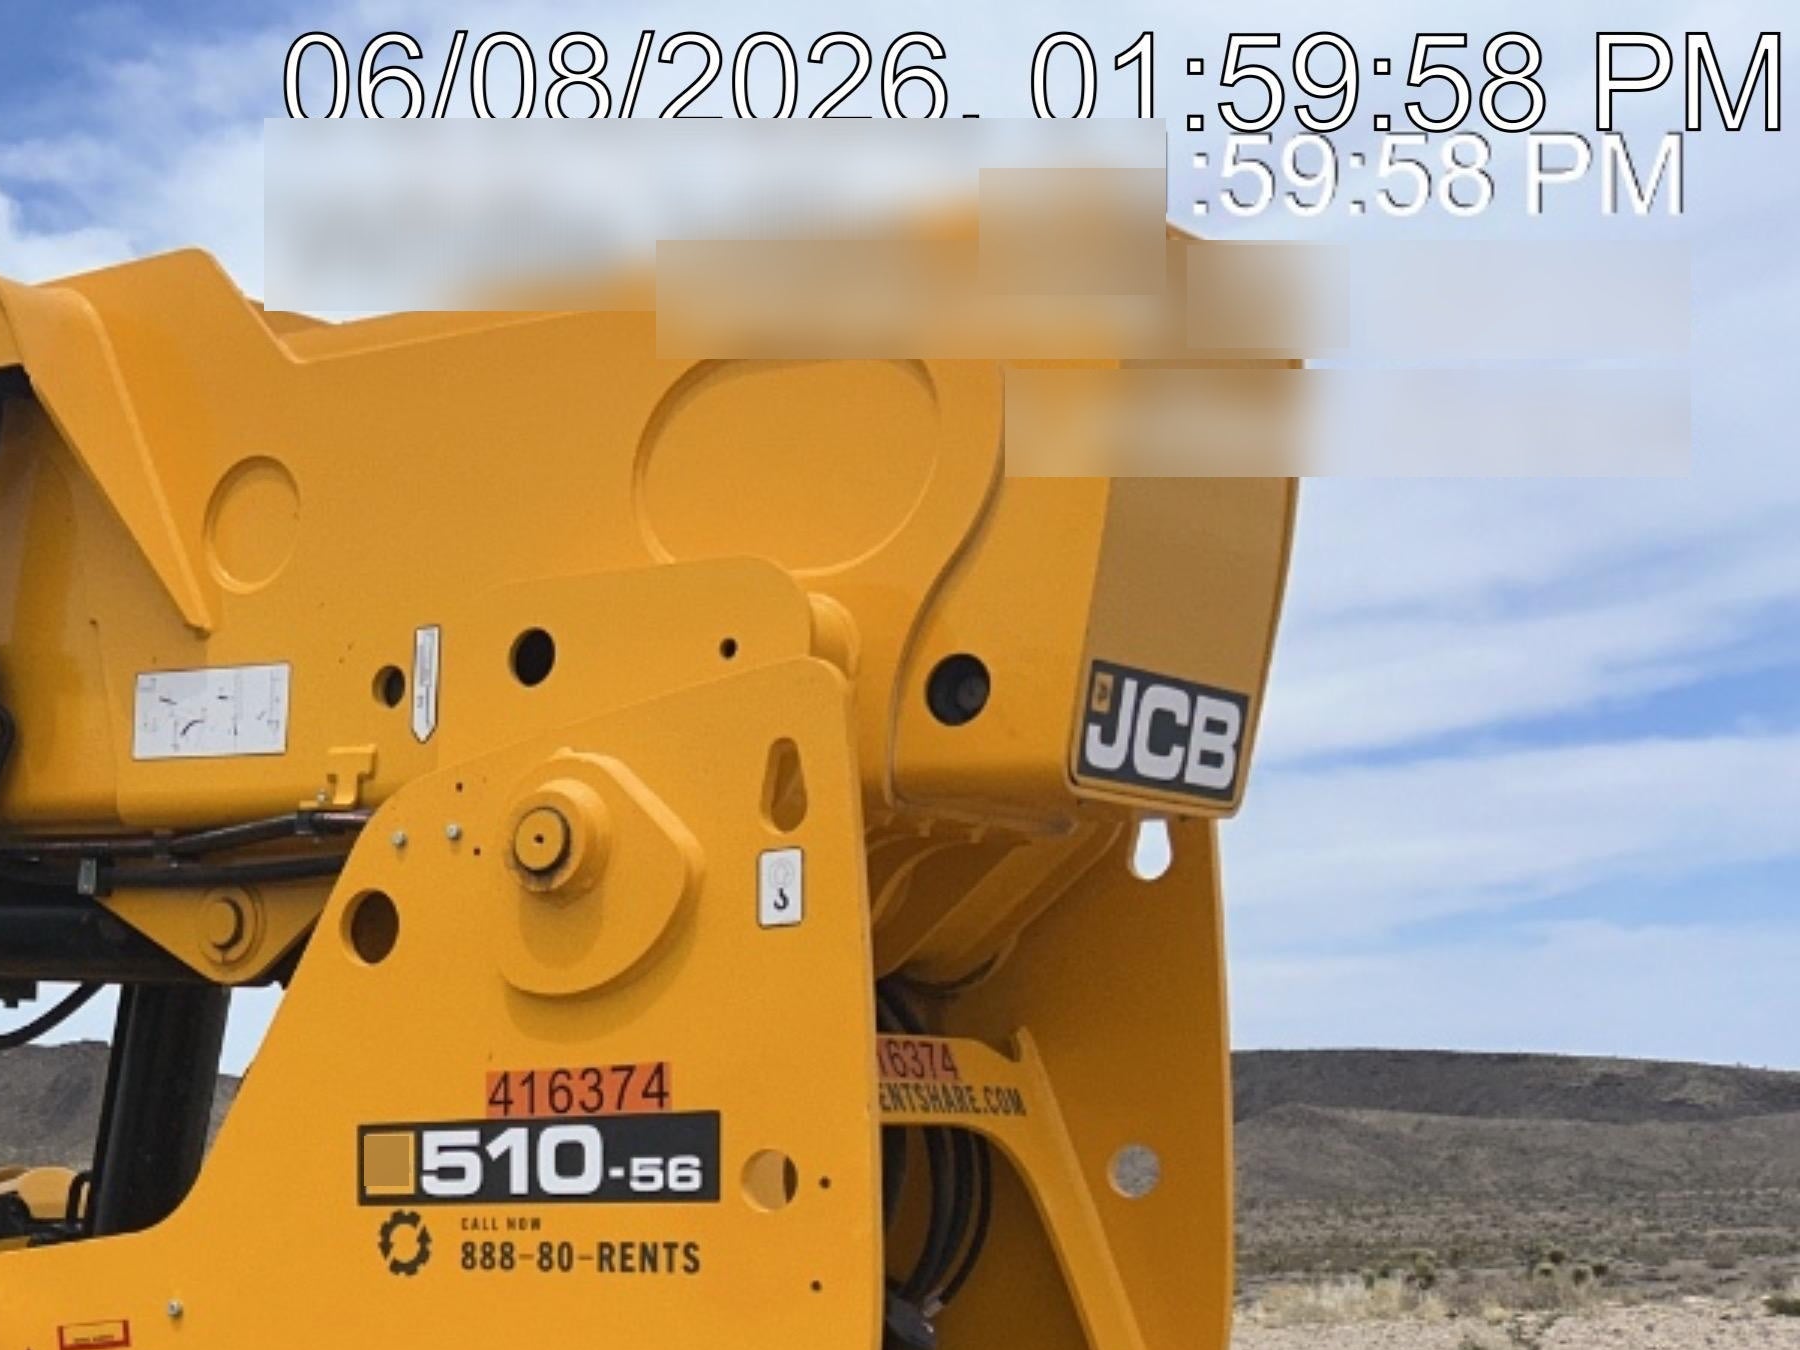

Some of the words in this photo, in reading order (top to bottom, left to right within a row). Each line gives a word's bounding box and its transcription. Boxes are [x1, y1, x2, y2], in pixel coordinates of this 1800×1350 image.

[1085, 677, 1242, 790] JCB
[487, 1062, 670, 1117] 416374
[421, 1124, 703, 1196] 510-56
[461, 1217, 499, 1231] CALL
[506, 1217, 542, 1231] NOW
[461, 1241, 701, 1275] 888-80-RENTS
